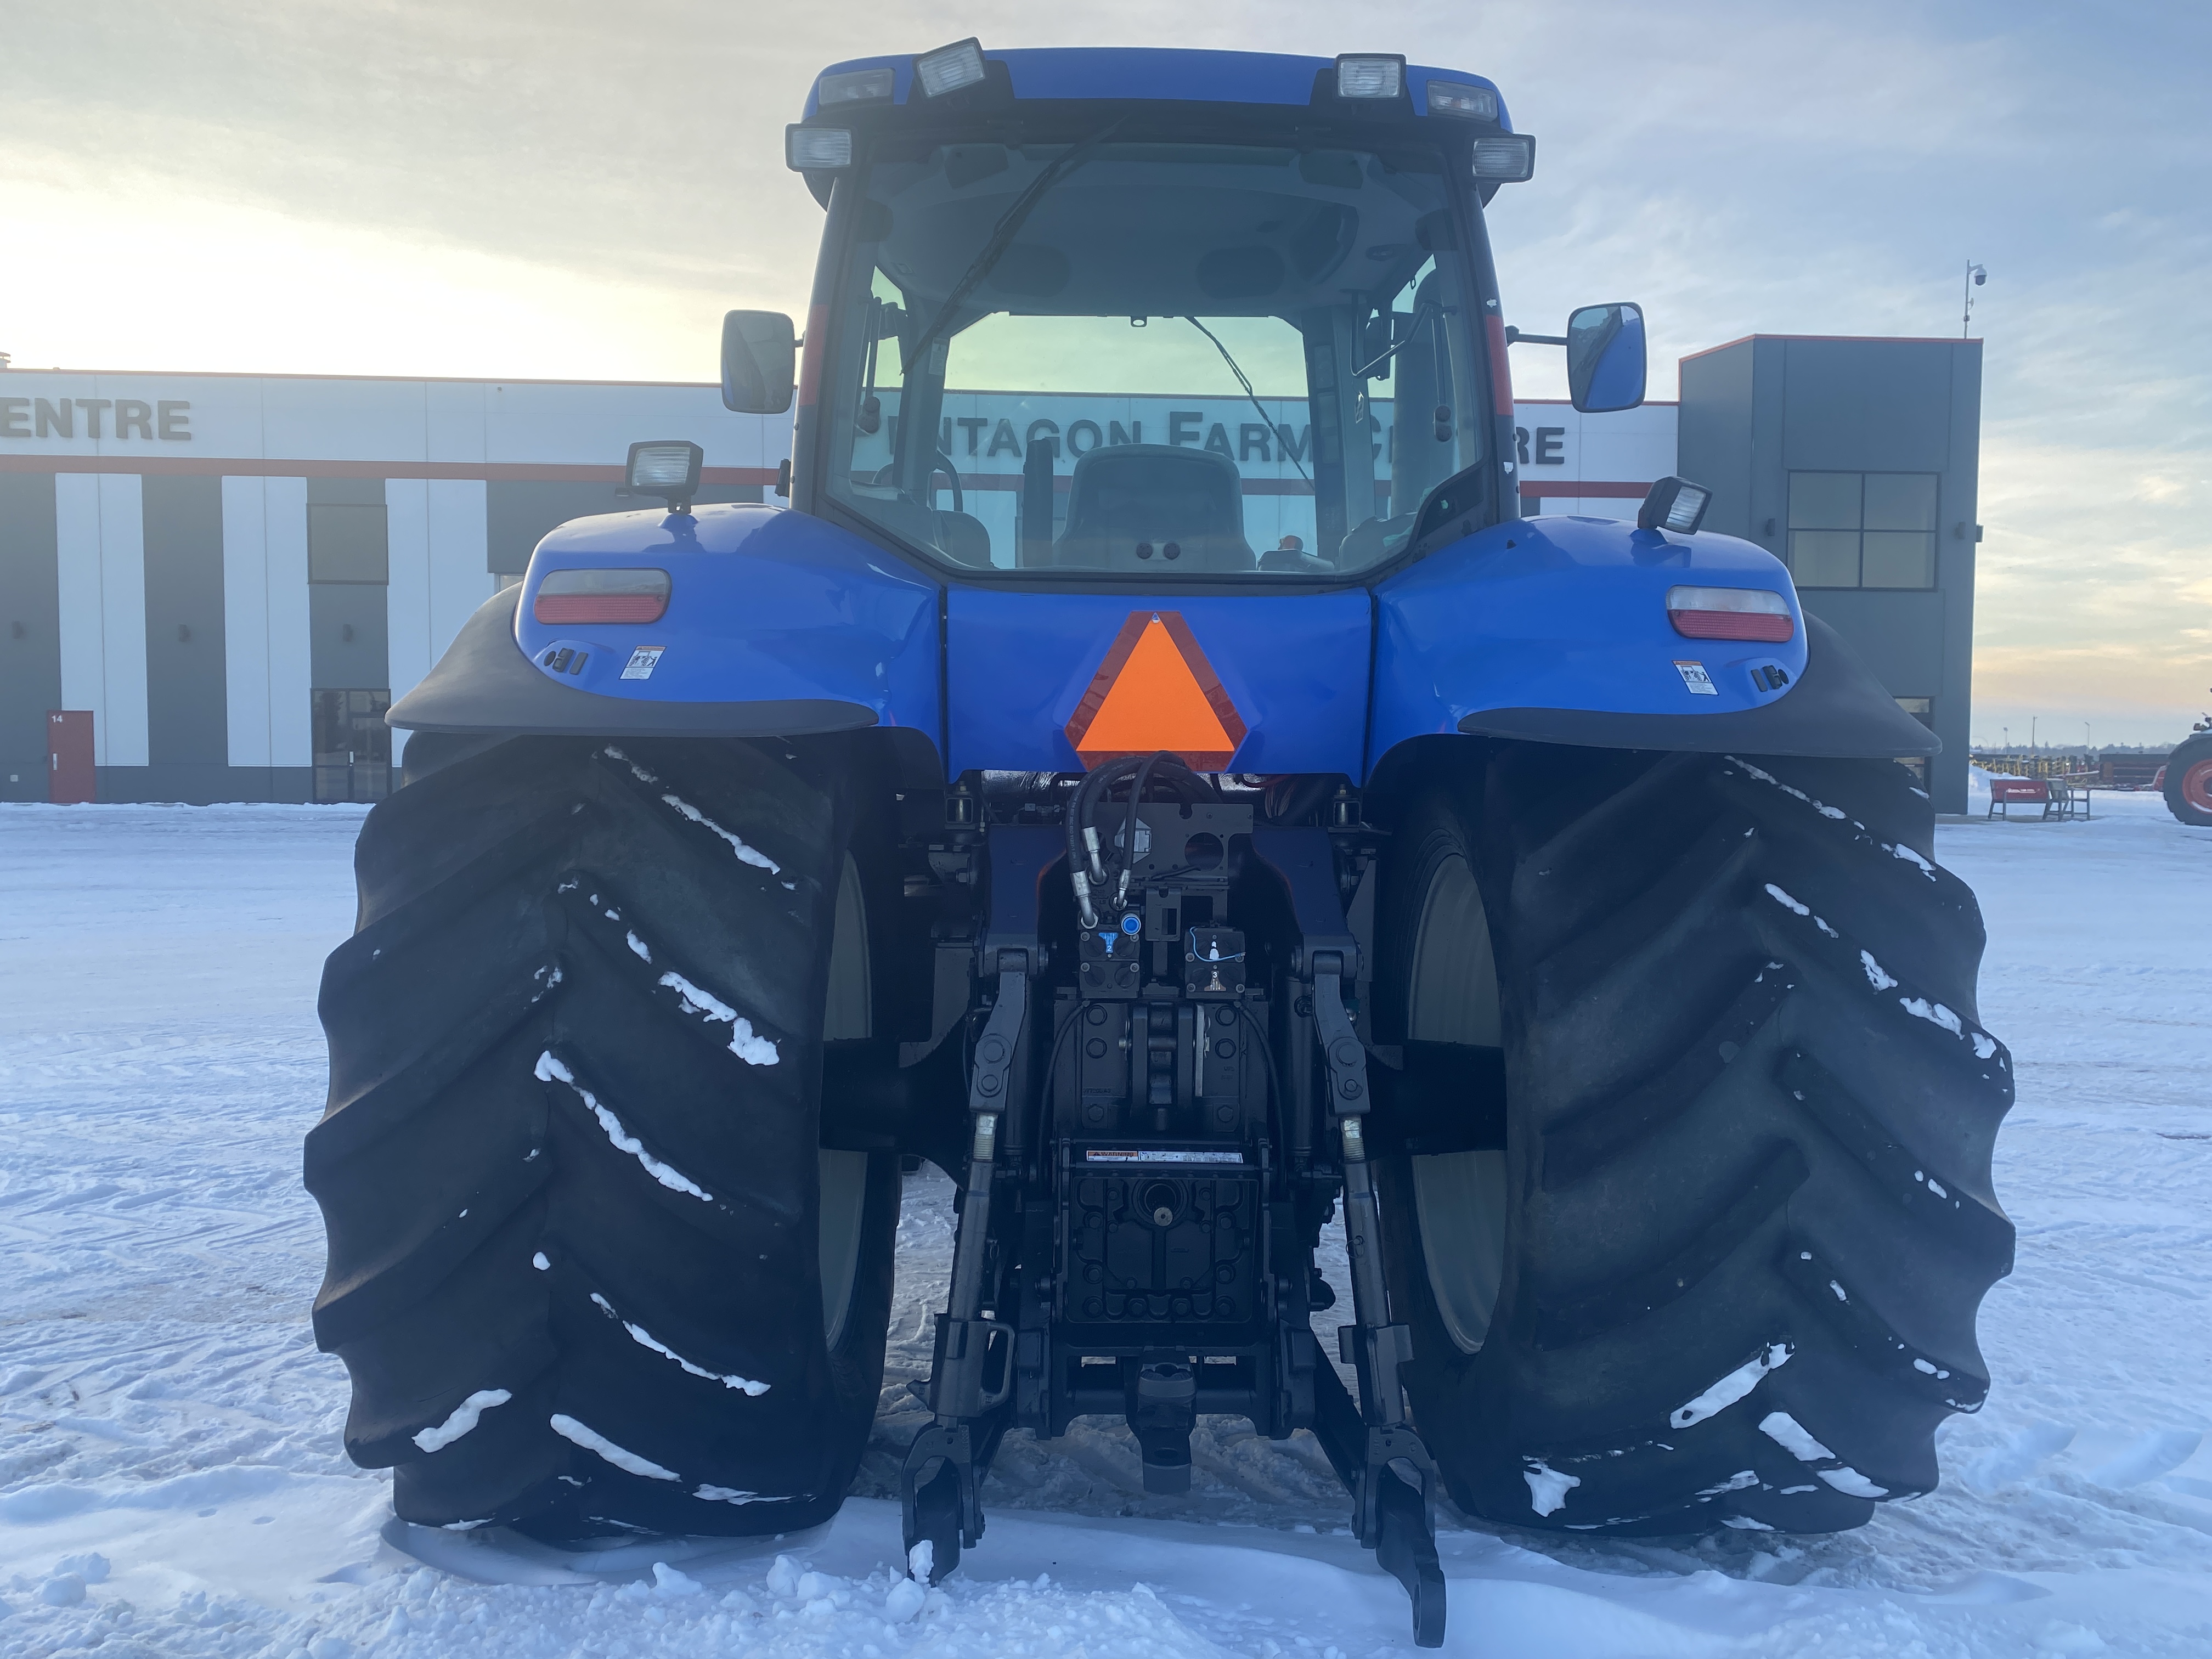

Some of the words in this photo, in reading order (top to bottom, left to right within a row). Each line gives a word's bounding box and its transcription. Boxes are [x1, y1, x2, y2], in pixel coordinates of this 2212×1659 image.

[0, 397, 191, 440] ENTRE
[1170, 411, 1313, 461] FARM
[52, 715, 63, 723] 14
